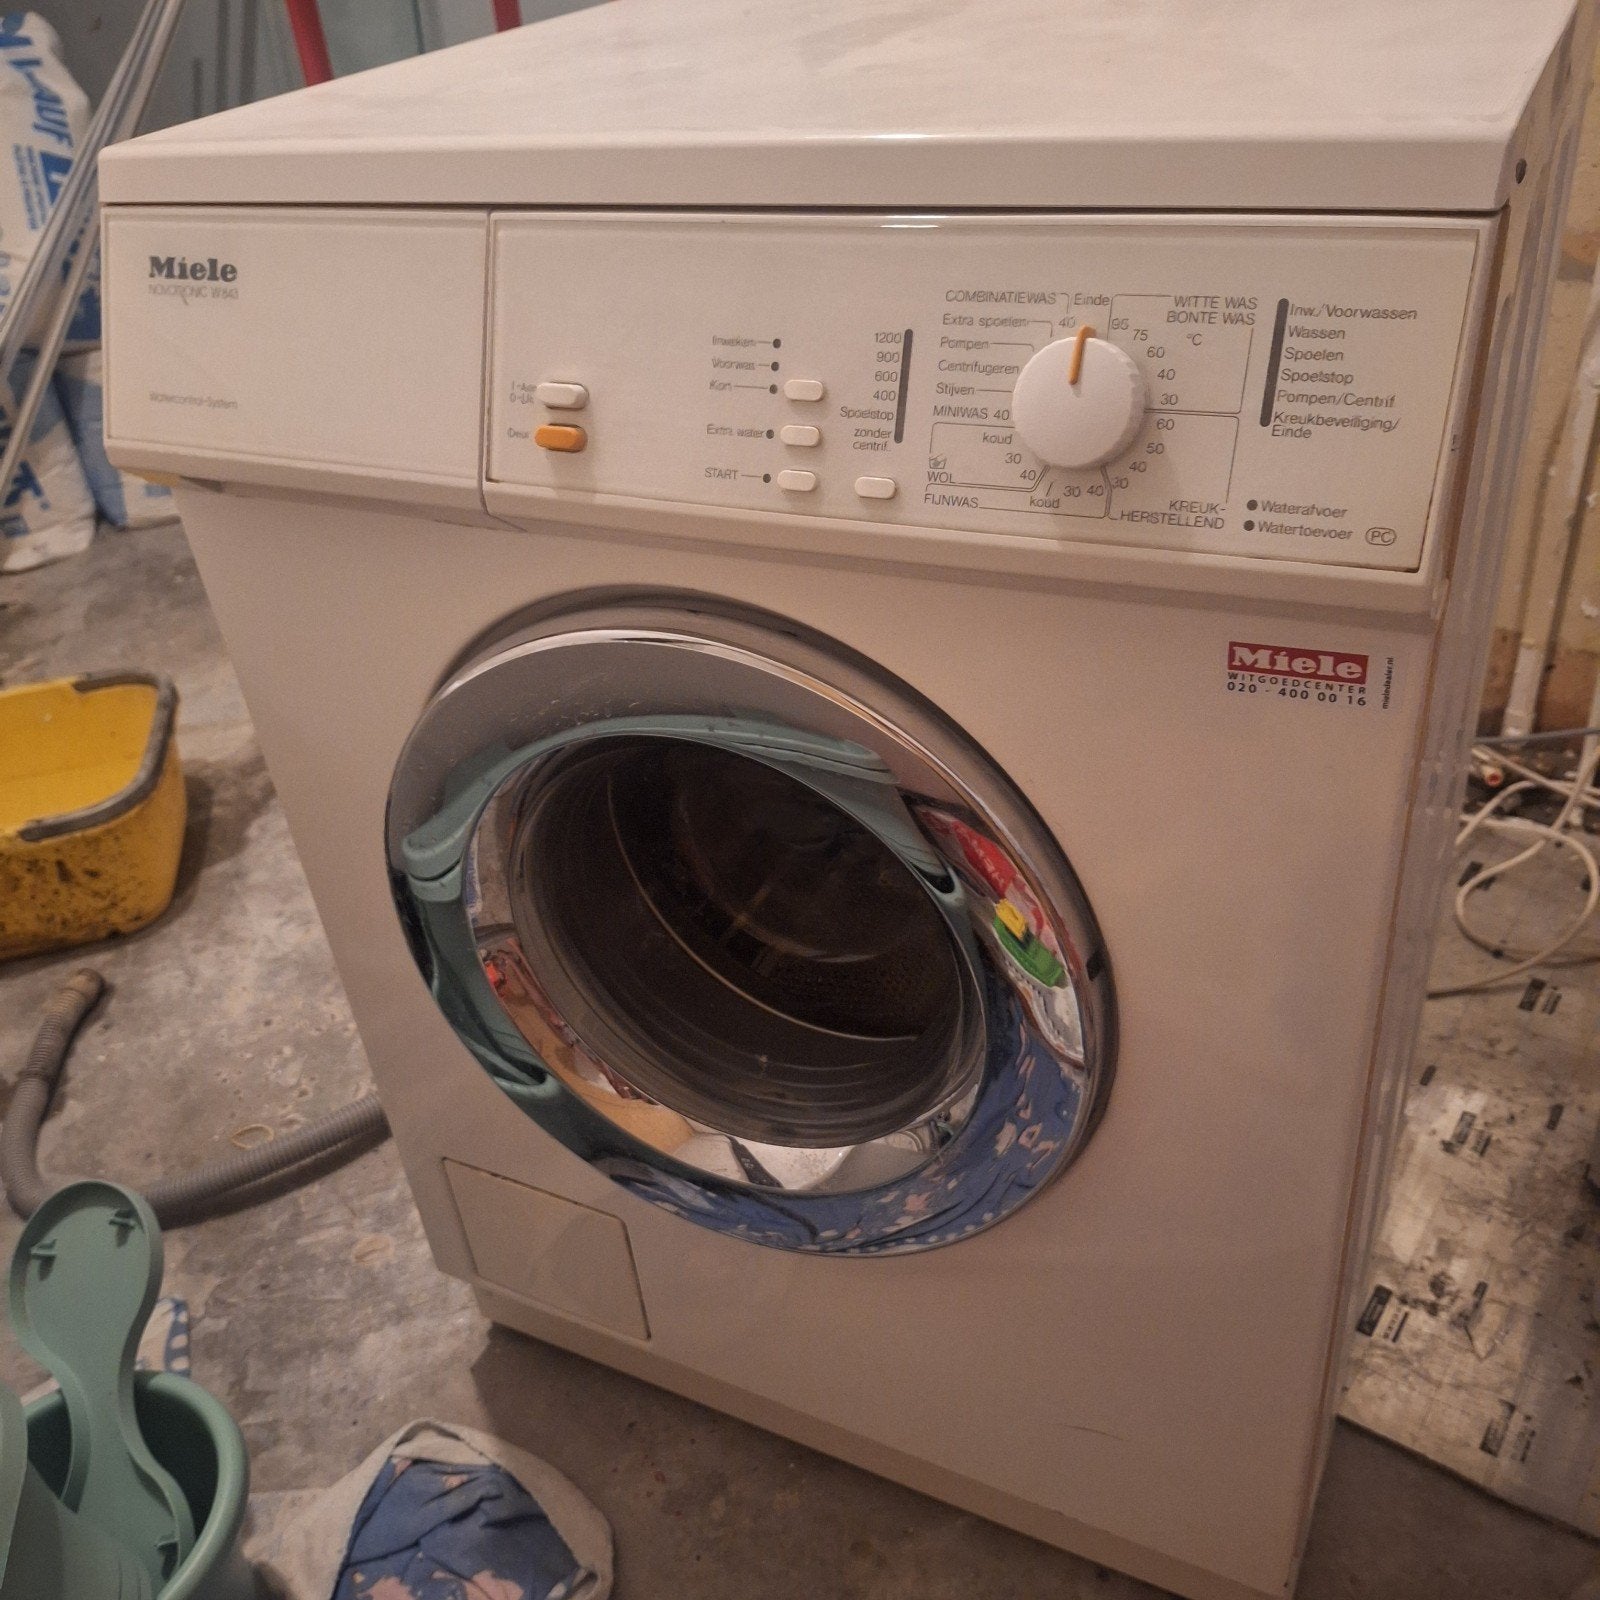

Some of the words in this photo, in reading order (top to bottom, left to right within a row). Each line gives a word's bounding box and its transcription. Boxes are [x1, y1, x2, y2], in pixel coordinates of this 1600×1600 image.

[149, 255, 238, 282] Miele
[945, 289, 1057, 305] COMBINATIEWAS
[1073, 293, 1110, 306] Einde
[1174, 295, 1220, 309] WITTE
[1225, 296, 1258, 310] WAS
[943, 313, 974, 326] Extra
[979, 316, 1029, 329] spoelen
[1058, 317, 1076, 328] 40
[1111, 318, 1129, 331] 95
[1167, 310, 1217, 324] BONTE
[1222, 312, 1256, 326] WAS
[874, 331, 902, 344] 1200
[1133, 328, 1149, 341] 75
[1288, 325, 1346, 339] Wassen
[940, 336, 989, 351] Pompen
[876, 352, 900, 363] 900
[1147, 346, 1165, 359] 60
[1284, 347, 1344, 362] Spoelen
[938, 359, 1020, 376] Centrifugeren
[1157, 368, 1176, 380] 40
[874, 371, 898, 383] 600
[1281, 368, 1354, 386] Spoelstop
[873, 390, 897, 401] 400
[936, 382, 975, 397] Stijven
[1160, 393, 1178, 405] 30
[840, 406, 894, 421] Spoelstop
[932, 405, 988, 419] MINIWAS
[993, 409, 1010, 421] 40
[1156, 418, 1175, 431] 60
[737, 426, 766, 438] water
[854, 427, 892, 439] zonder
[1271, 425, 1312, 438] Einde
[982, 432, 1013, 445] koud
[1146, 442, 1165, 454] 50
[1004, 452, 1022, 464] 30
[704, 467, 739, 480] START
[1129, 461, 1147, 473] 40
[927, 471, 955, 484] WOL
[1019, 469, 1036, 481] 40
[1112, 477, 1129, 489] 30
[1063, 486, 1081, 498] 30
[1086, 485, 1104, 497] 40
[924, 493, 979, 509] FIJNWAS
[1029, 496, 1060, 509] koud
[1169, 500, 1226, 514] KREUK-
[1261, 500, 1348, 518] Waterafvoer
[1121, 510, 1225, 529] HERSTELLEND
[1258, 521, 1354, 540] Watertoevoer
[1370, 531, 1392, 544] PC
[1231, 646, 1363, 679] Miele
[1228, 671, 1367, 695] WITGOEDCENTER
[1227, 681, 1257, 694] 020
[1278, 687, 1309, 700] 400
[1317, 692, 1338, 703] 00
[1347, 695, 1367, 707] 16
